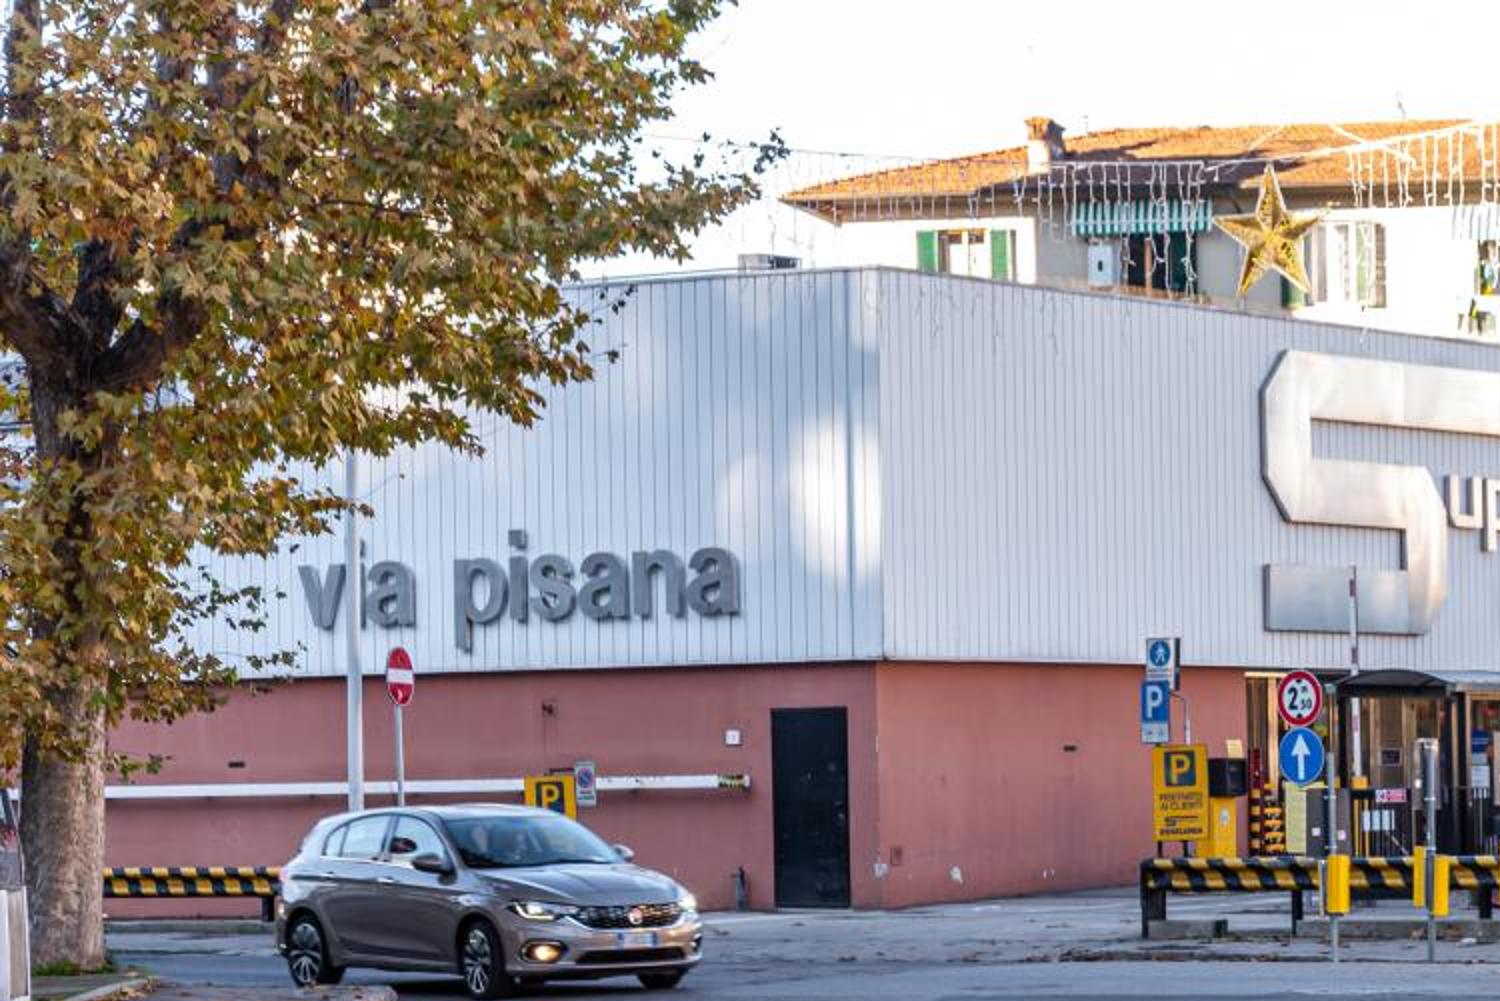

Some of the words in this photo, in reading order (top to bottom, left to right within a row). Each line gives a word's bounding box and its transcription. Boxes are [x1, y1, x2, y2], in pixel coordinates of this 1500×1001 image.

[454, 529, 740, 654] pisana
[1145, 685, 1163, 719] P
[1170, 755, 1190, 784] P
[541, 783, 560, 810] P
